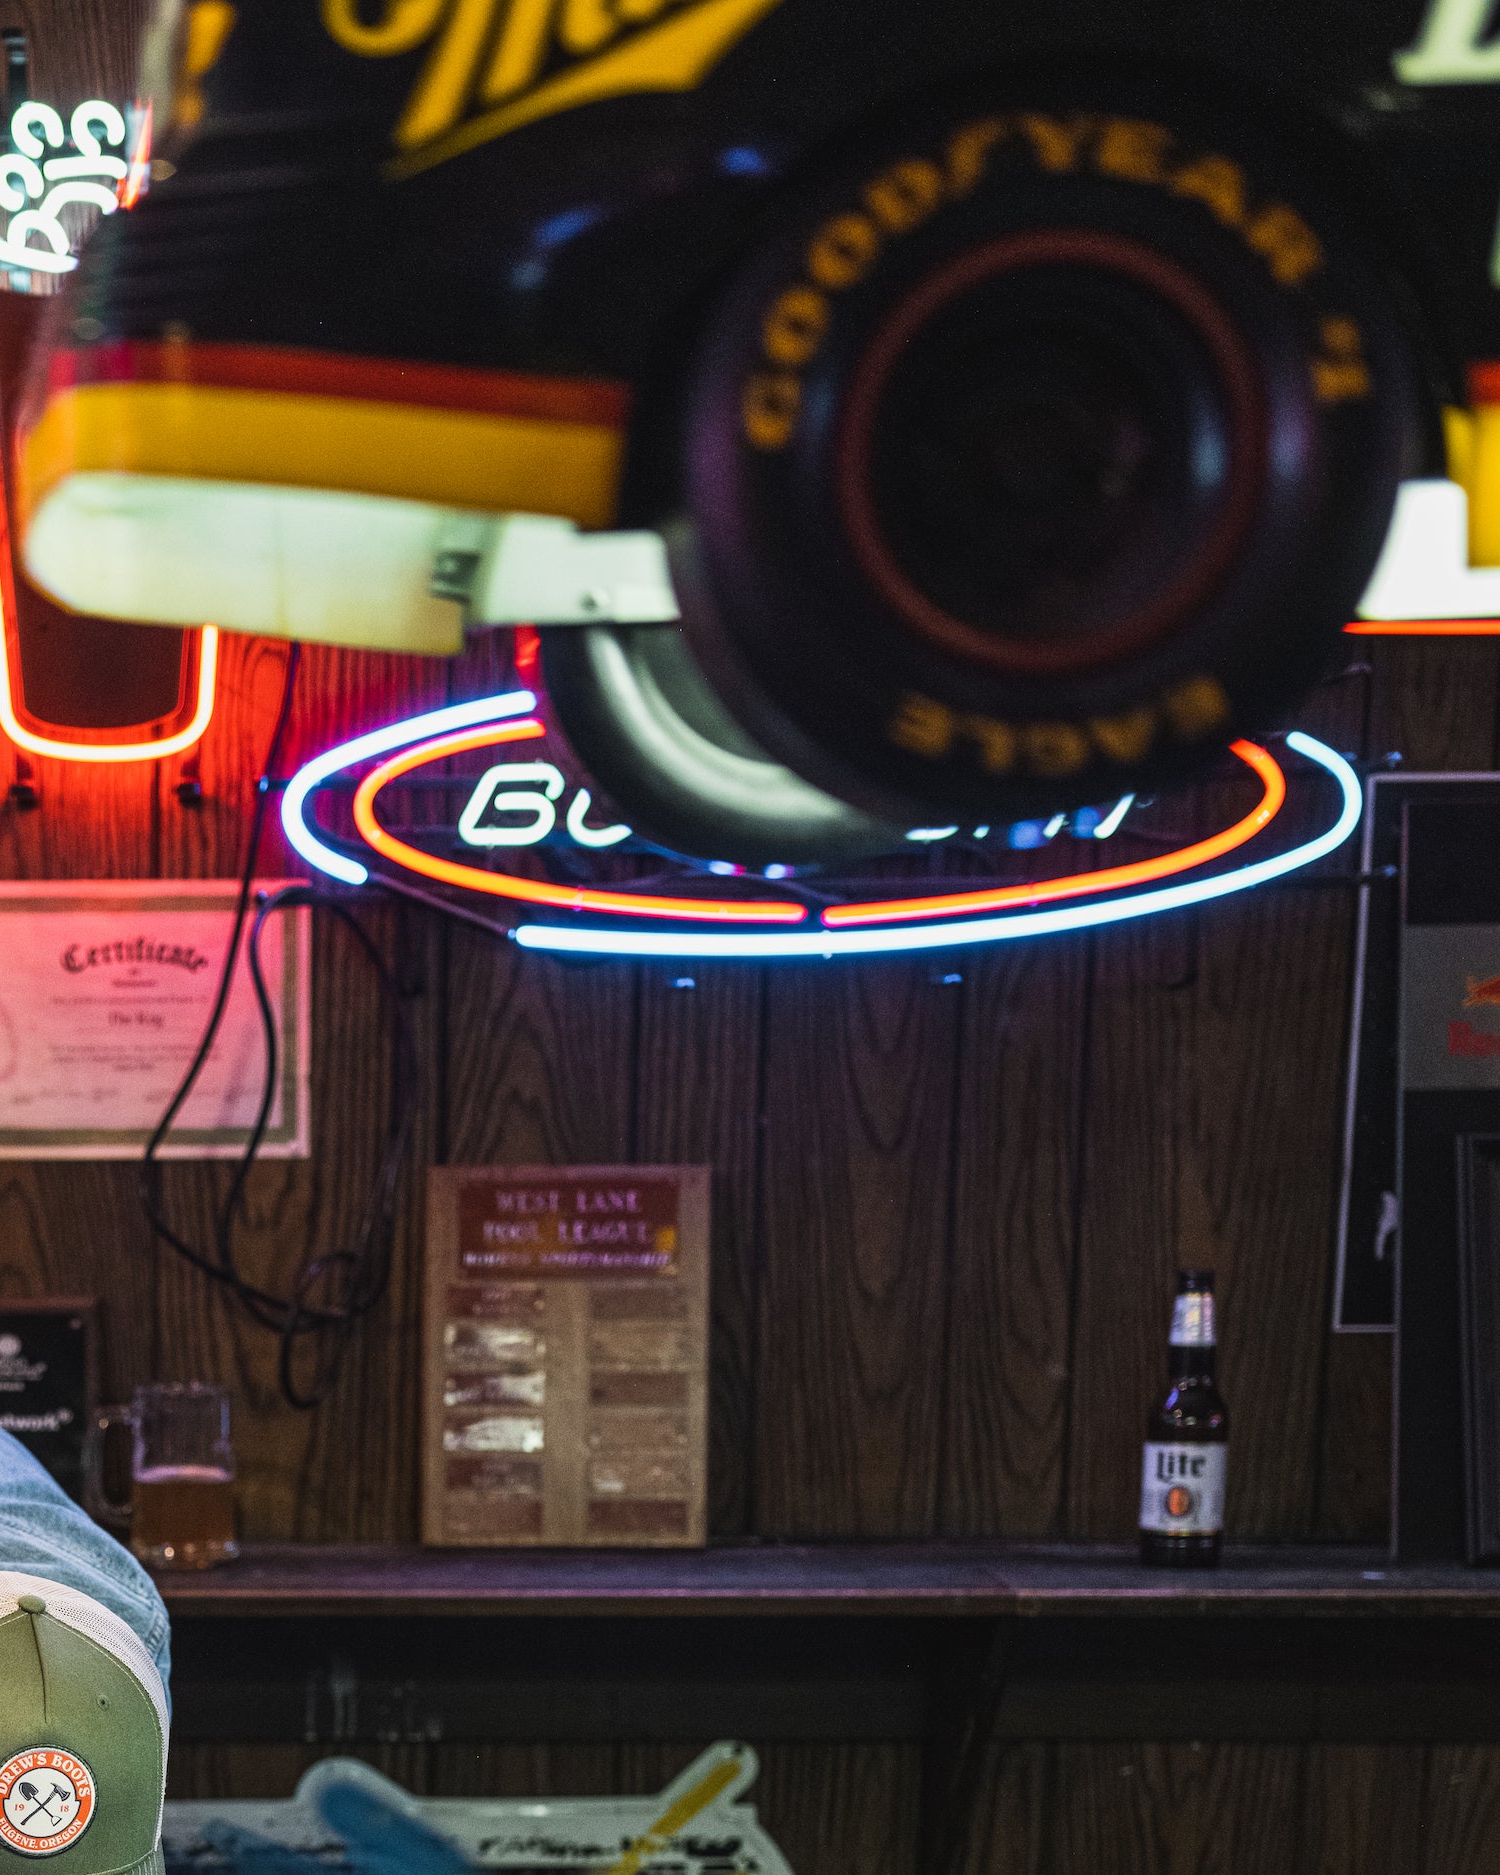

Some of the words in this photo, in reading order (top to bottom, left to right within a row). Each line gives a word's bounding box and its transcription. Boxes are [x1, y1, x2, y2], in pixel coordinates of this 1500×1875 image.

[1157, 1450, 1207, 1484] Lite
[50, 1754, 91, 1798] BOOTS
[13, 1803, 26, 1812] 19
[59, 1803, 70, 1813] 18
[39, 1817, 83, 1849] OREGON
